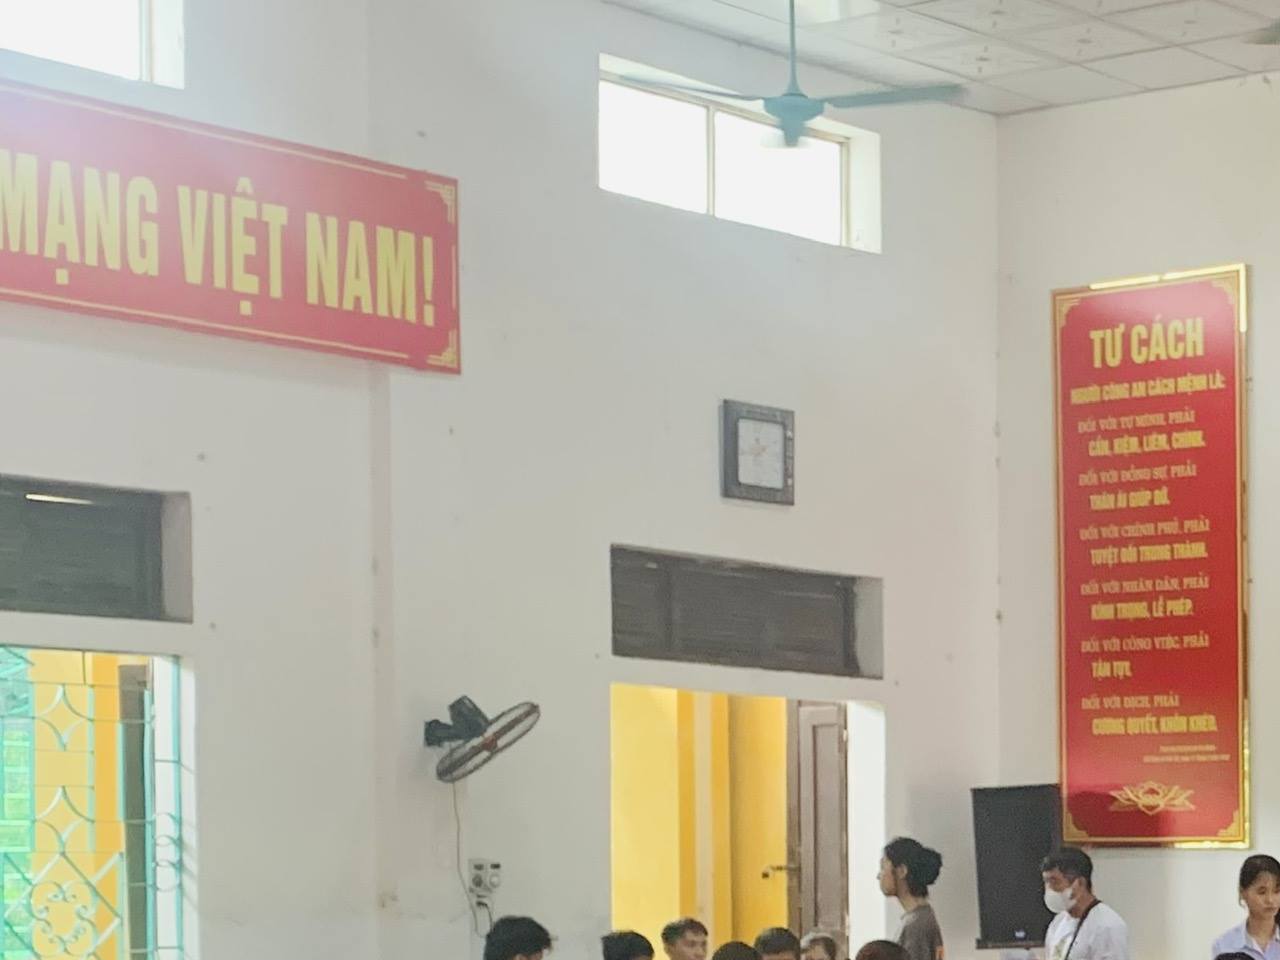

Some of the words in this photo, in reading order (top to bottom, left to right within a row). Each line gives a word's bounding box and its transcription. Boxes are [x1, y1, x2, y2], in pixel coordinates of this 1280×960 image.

[0, 148, 160, 285] MẠNG
[177, 177, 288, 316] VIỆT
[305, 212, 435, 327] NAM!
[1089, 323, 1125, 368] TƯ
[1130, 314, 1205, 364] CÁCH
